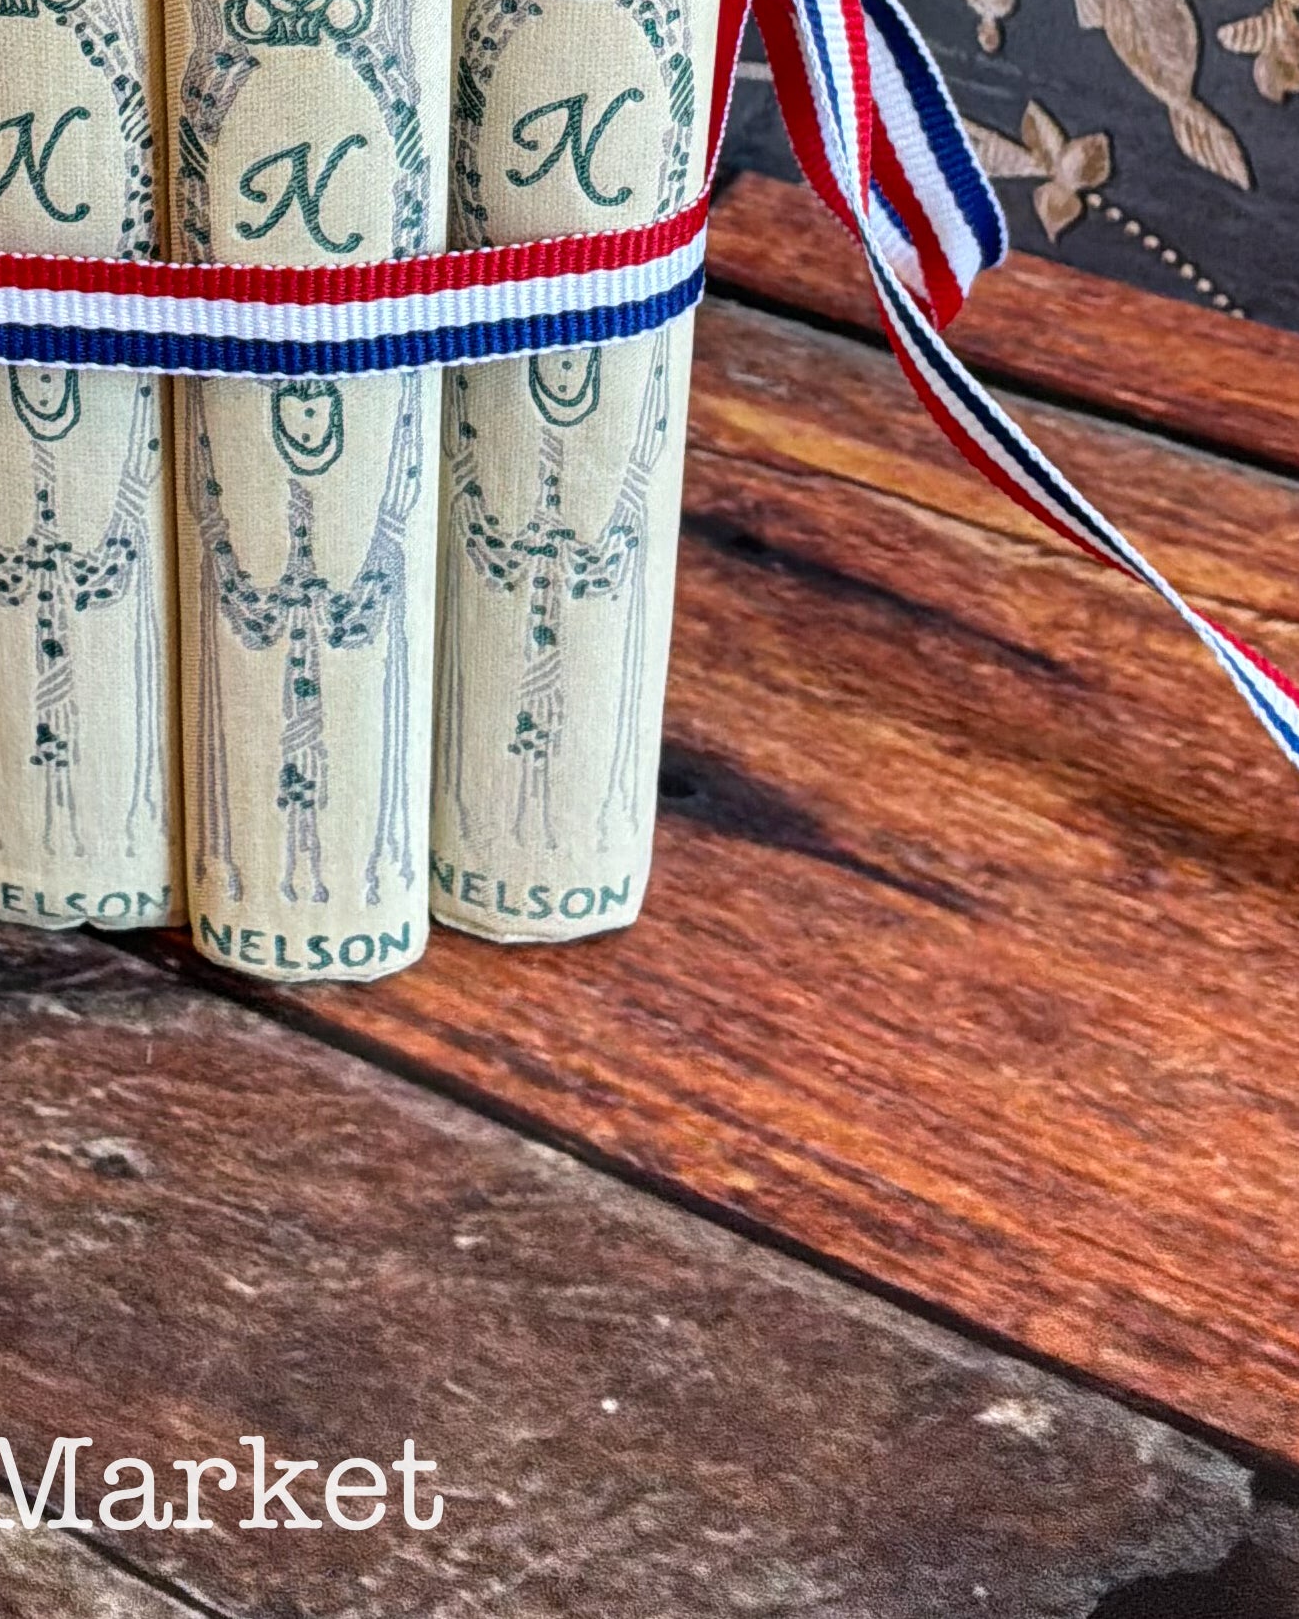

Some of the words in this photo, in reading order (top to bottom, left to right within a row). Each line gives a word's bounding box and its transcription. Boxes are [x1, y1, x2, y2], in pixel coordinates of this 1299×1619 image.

[235, 133, 369, 254] N
[506, 87, 644, 207] N
[430, 855, 631, 921] NELSON
[200, 917, 413, 971] NELSON
